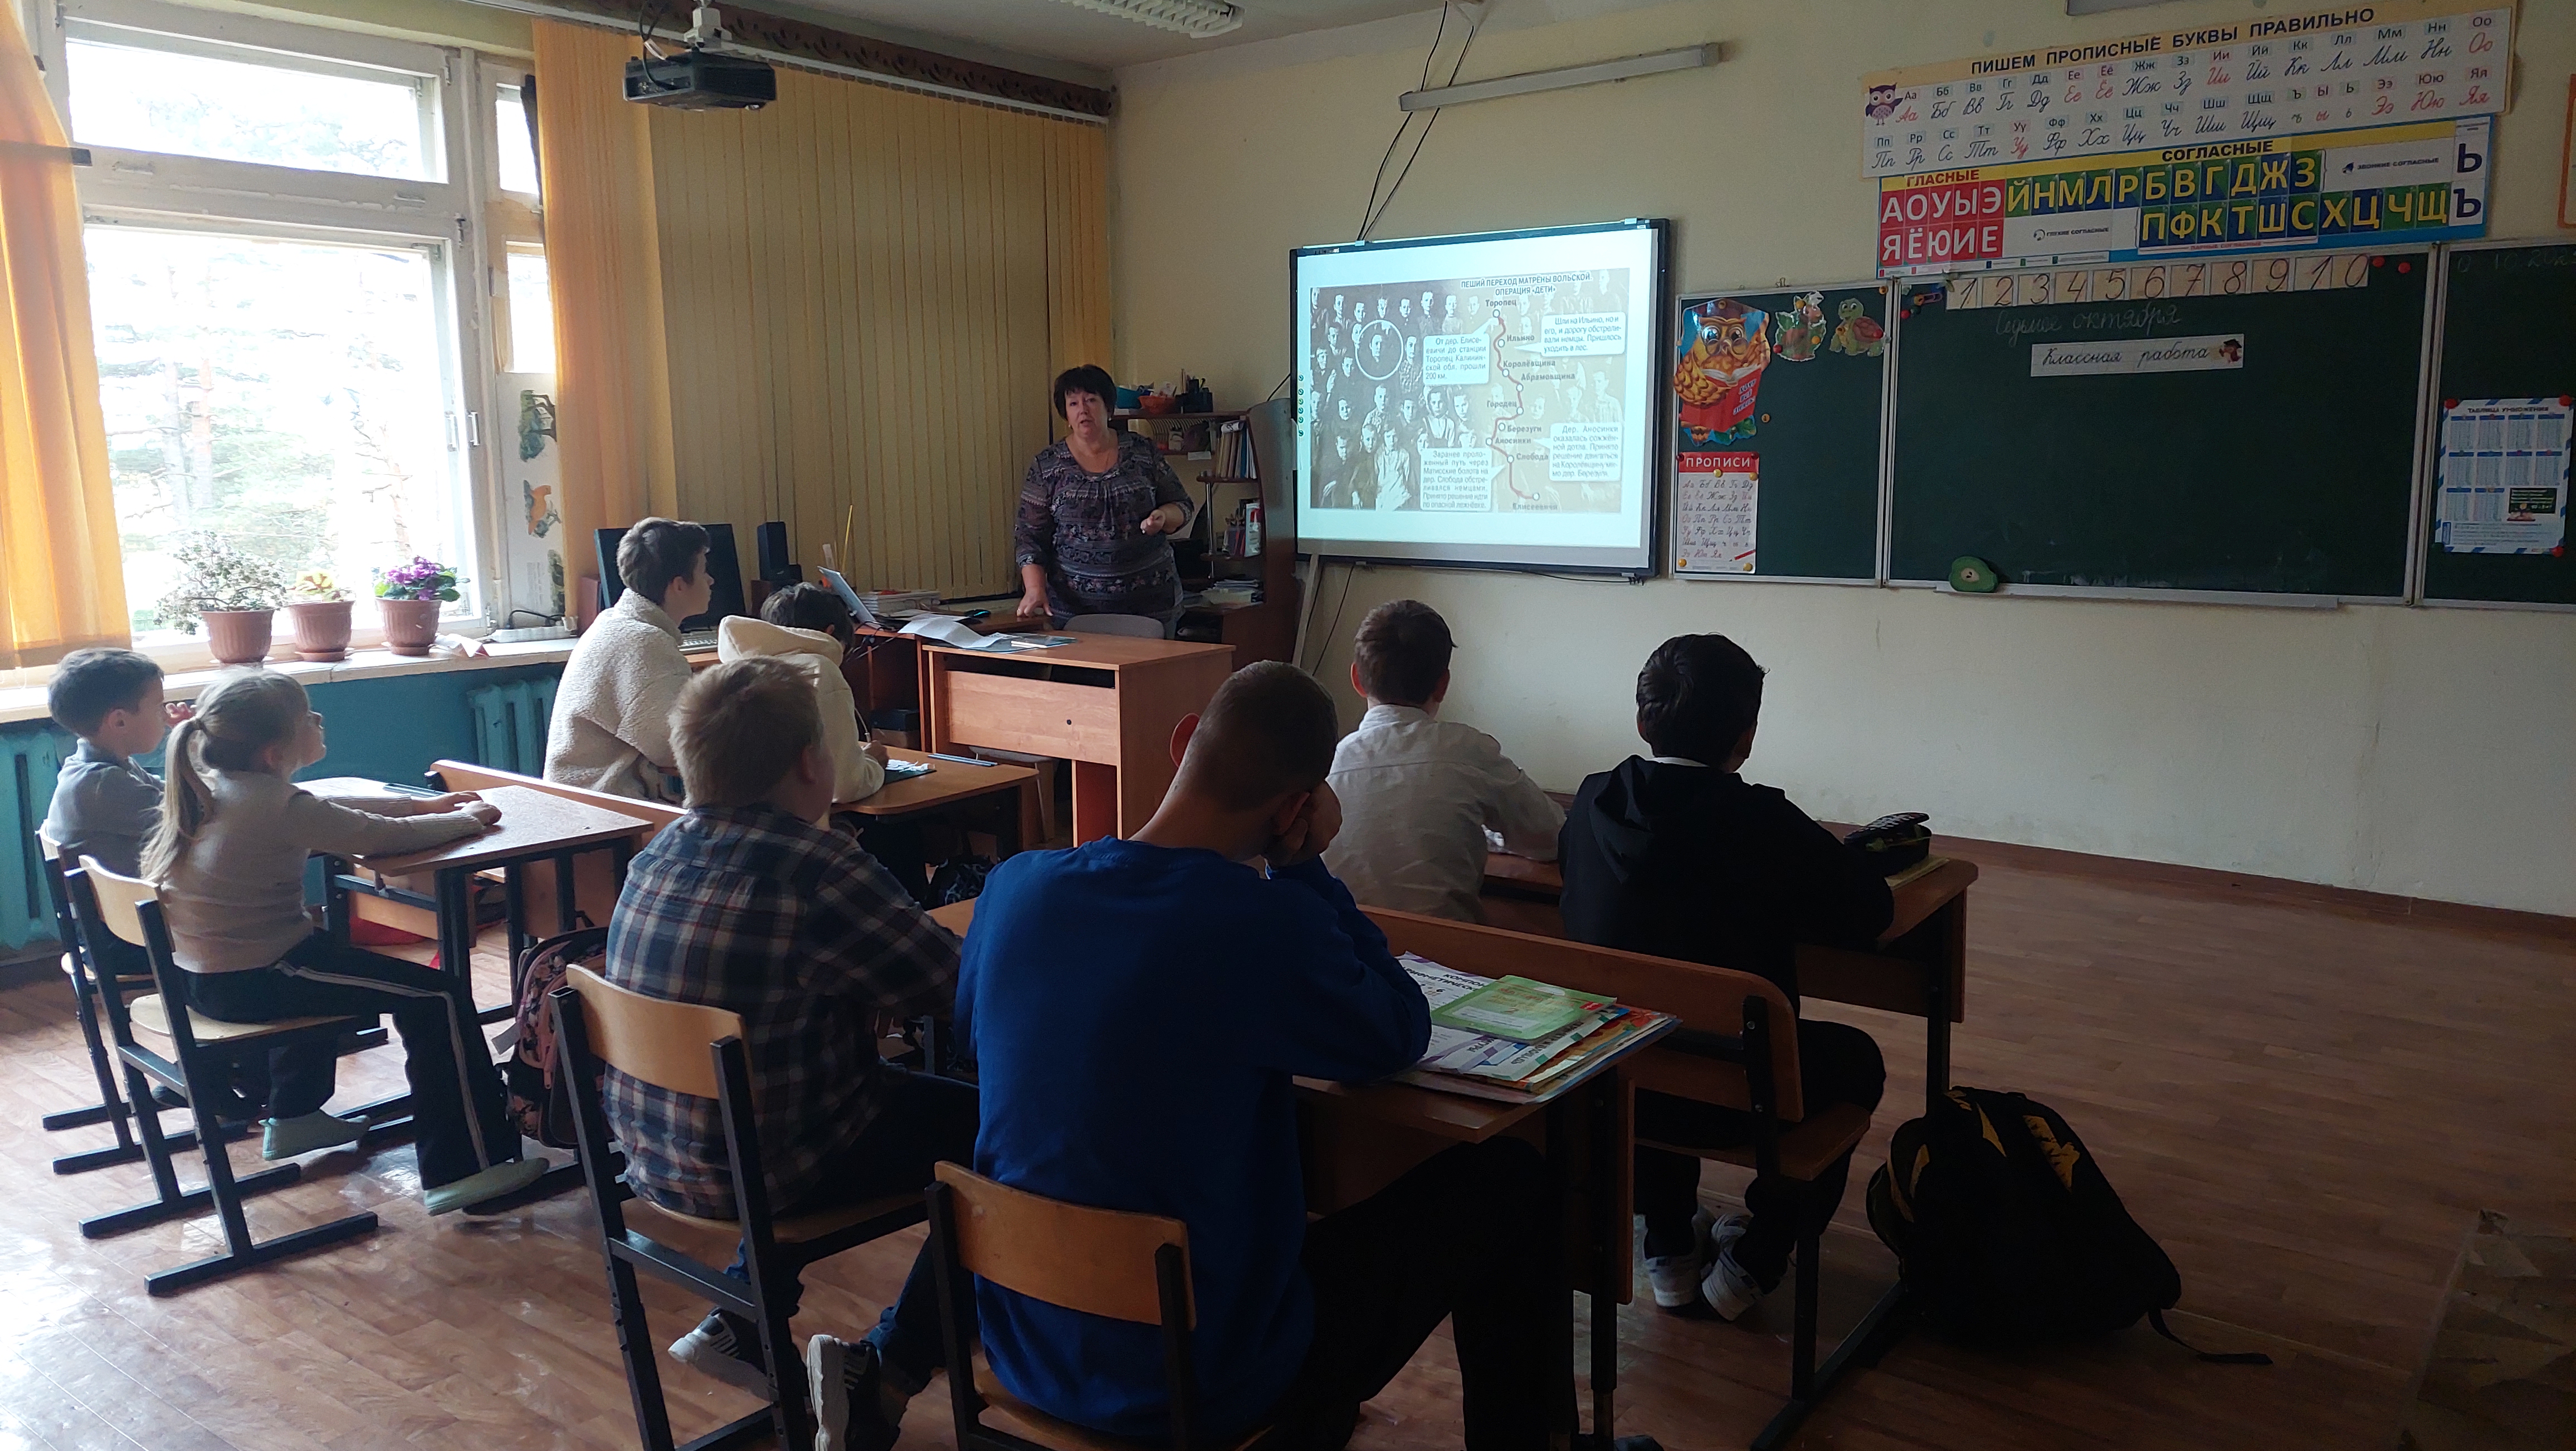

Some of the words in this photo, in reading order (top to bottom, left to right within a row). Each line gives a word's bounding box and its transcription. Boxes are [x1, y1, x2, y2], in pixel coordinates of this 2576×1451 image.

[1971, 55, 2035, 75] ПИШЕМ
[2046, 36, 2162, 66] ПРОПИСНЫЕ
[2173, 26, 2238, 48] БУКВЫ
[2250, 7, 2375, 38] ПРАВИЛЬНО
[1905, 91, 1917, 100] Аа
[1936, 87, 1949, 96] Бб
[1969, 83, 1982, 92] Вв
[2003, 79, 2012, 88] Гг
[2032, 74, 2048, 85] Дд
[2068, 71, 2080, 80] Ее
[2101, 65, 2114, 76] Ёё
[2134, 61, 2155, 71] Жж
[2177, 56, 2189, 66] Зз
[2213, 51, 2230, 61] Ии
[2252, 45, 2268, 56] Йй
[2293, 41, 2307, 51] Кк
[2334, 35, 2351, 45] Лл
[2378, 29, 2402, 40] Мм
[2428, 22, 2446, 33] Нн
[2472, 17, 2492, 27] Оо
[1877, 137, 1890, 147] Пп
[1910, 133, 1923, 143] Рр
[1943, 129, 1955, 139] Сс
[1978, 125, 1990, 135] Тт
[2013, 122, 2027, 133] Уу
[2048, 118, 2065, 128] Фф
[2090, 113, 2103, 123] Хх
[2125, 109, 2142, 119] Цц
[2165, 103, 2179, 113] Чч
[2203, 98, 2226, 109] Шш
[2247, 93, 2272, 105] Щщ
[2292, 89, 2301, 100] Ъ
[2318, 85, 2329, 97] Ы
[2346, 82, 2354, 94] Ь
[2377, 79, 2393, 90] Ээ
[2418, 73, 2444, 85] Юю
[2470, 68, 2488, 79] Яя
[2162, 139, 2273, 163] СОГЛАСНЫЕ
[2457, 143, 2483, 174] Ь
[1906, 169, 1980, 189] ГЛАСНЫЕ
[2454, 187, 2481, 219] Ъ
[1461, 279, 1485, 288] ПЕШИЙ
[1486, 277, 1518, 287] ПЕРЕХОД
[1495, 286, 1531, 296] ОПЕРАЦИЯ
[1960, 278, 1978, 309] 1
[1994, 275, 2014, 306] 2
[2030, 274, 2050, 304] 3
[2067, 271, 2086, 303] 4
[2105, 268, 2126, 300] 5
[2145, 266, 2166, 299] 6
[2185, 263, 2206, 297] 7
[2224, 261, 2247, 294] 8
[2266, 257, 2289, 292] 9
[1485, 299, 1517, 308] Торопец
[2072, 301, 2183, 337] октября
[1435, 337, 1444, 345] От
[1426, 355, 1453, 363] Торопец
[2042, 348, 2121, 366] Классная
[2136, 340, 2210, 368] работа
[1425, 372, 1437, 380] 200
[1686, 457, 1751, 468] ПРОПИСИ
